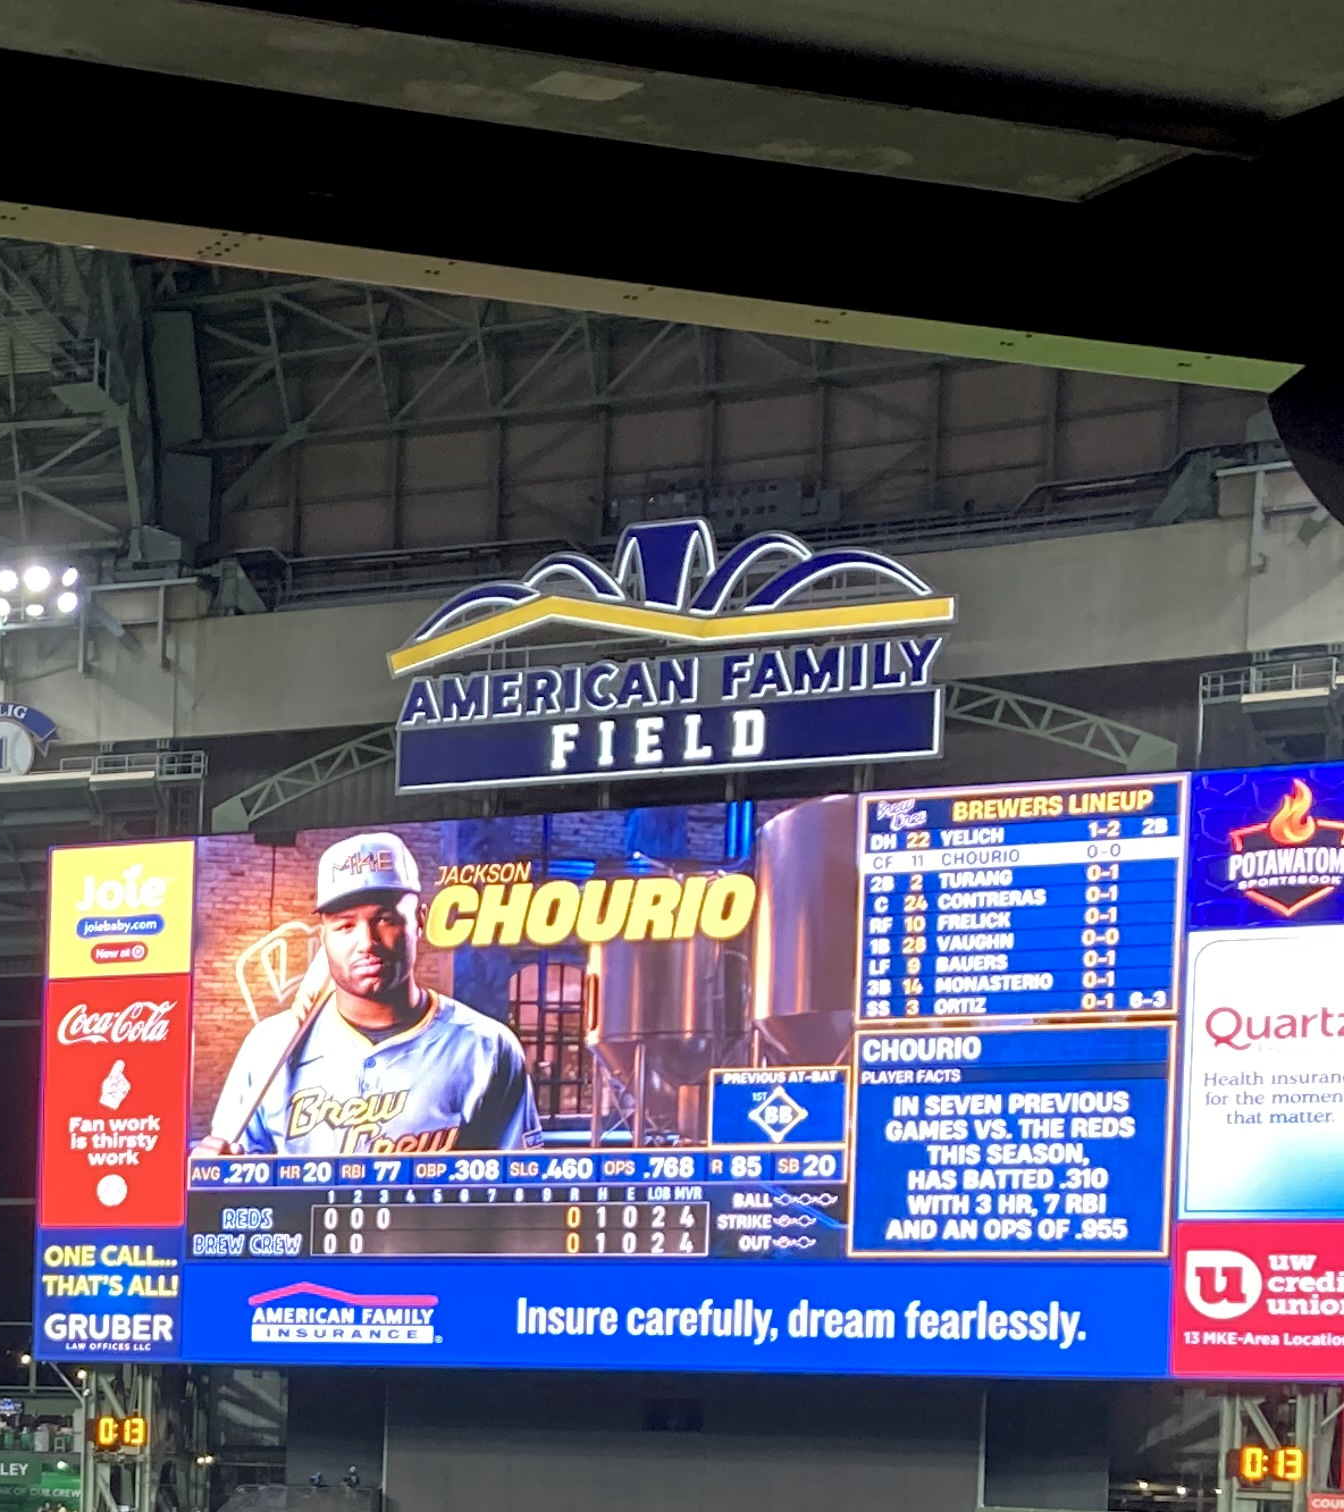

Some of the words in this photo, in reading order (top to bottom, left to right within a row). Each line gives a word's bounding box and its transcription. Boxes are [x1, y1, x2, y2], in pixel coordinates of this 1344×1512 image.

[400, 655, 698, 726] AMERICAN
[722, 636, 943, 698] FAMILY
[551, 710, 765, 770] FIELD
[952, 797, 1062, 822] BREWERS
[1068, 790, 1153, 815] LINEUP
[940, 828, 1004, 846] YELICH
[942, 850, 1020, 866] CHOURIO
[435, 862, 532, 885] JACKSON
[938, 870, 1012, 889] TURANG
[1238, 875, 1341, 890] SPORTSBOOK
[76, 864, 167, 912] Joie
[426, 873, 756, 947] CHOURIO
[938, 889, 1046, 910] CONTRERAS
[83, 919, 157, 935] joiebaby.com
[937, 912, 1010, 931] FRELICK
[936, 933, 1014, 952] VAUGHN
[936, 955, 1007, 972] BAUERS
[935, 973, 1052, 993] MONASTERIO
[934, 997, 986, 1014] ORTIZ
[58, 1000, 177, 1045] Coca-Cola
[862, 1037, 981, 1062] CHOURIO
[862, 1070, 913, 1084] PLAYER
[916, 1069, 961, 1083] FACTS
[893, 1096, 918, 1116] IN
[924, 1094, 1002, 1115] SEVEN
[1008, 1092, 1129, 1113] PREVIOUS
[69, 1116, 108, 1134] Fan
[113, 1114, 160, 1133] work
[885, 1121, 968, 1141] GAMES
[974, 1120, 1011, 1139] VS.
[1018, 1119, 1064, 1138] THE
[1071, 1117, 1135, 1138] REDS
[92, 1132, 157, 1152] thirsty
[88, 1149, 139, 1166] work
[926, 1145, 980, 1165] THIS
[986, 1144, 1089, 1166] SEASON,
[908, 1170, 957, 1190] HAS
[964, 1169, 1053, 1189] BATTED
[1059, 1168, 1108, 1189] .310
[907, 1194, 970, 1214] WITH
[975, 1195, 991, 1214] 3
[998, 1194, 1037, 1217] HR,
[1043, 1194, 1059, 1214] 7
[1065, 1194, 1106, 1214] RBI
[222, 1207, 273, 1229] REDS
[717, 1214, 772, 1229] STRIKE
[885, 1220, 937, 1239] AND
[943, 1220, 977, 1239] AN
[984, 1220, 1032, 1239] OPS
[1038, 1219, 1070, 1239] OF
[1075, 1219, 1127, 1239] .955
[193, 1234, 242, 1255] BREW
[250, 1234, 303, 1255] CREW
[44, 1246, 97, 1268] ONE
[1268, 1254, 1317, 1271] uw
[42, 1276, 123, 1298] THAT'S
[127, 1275, 178, 1297] ALL!
[252, 1307, 357, 1325] AMERICAN
[361, 1307, 435, 1325] FAMILY
[516, 1298, 619, 1337] Insure
[625, 1298, 779, 1345] carefully,
[787, 1299, 895, 1340] dream
[905, 1299, 1087, 1350] fearlessly.
[44, 1313, 173, 1342] GRUBER
[266, 1327, 419, 1339] INSURANCE
[65, 1342, 87, 1351] LAW
[89, 1342, 129, 1351] OFFICES
[133, 1342, 151, 1351] LLC
[99, 1416, 144, 1446] 0:13
[1242, 1446, 1303, 1481] 0:13
